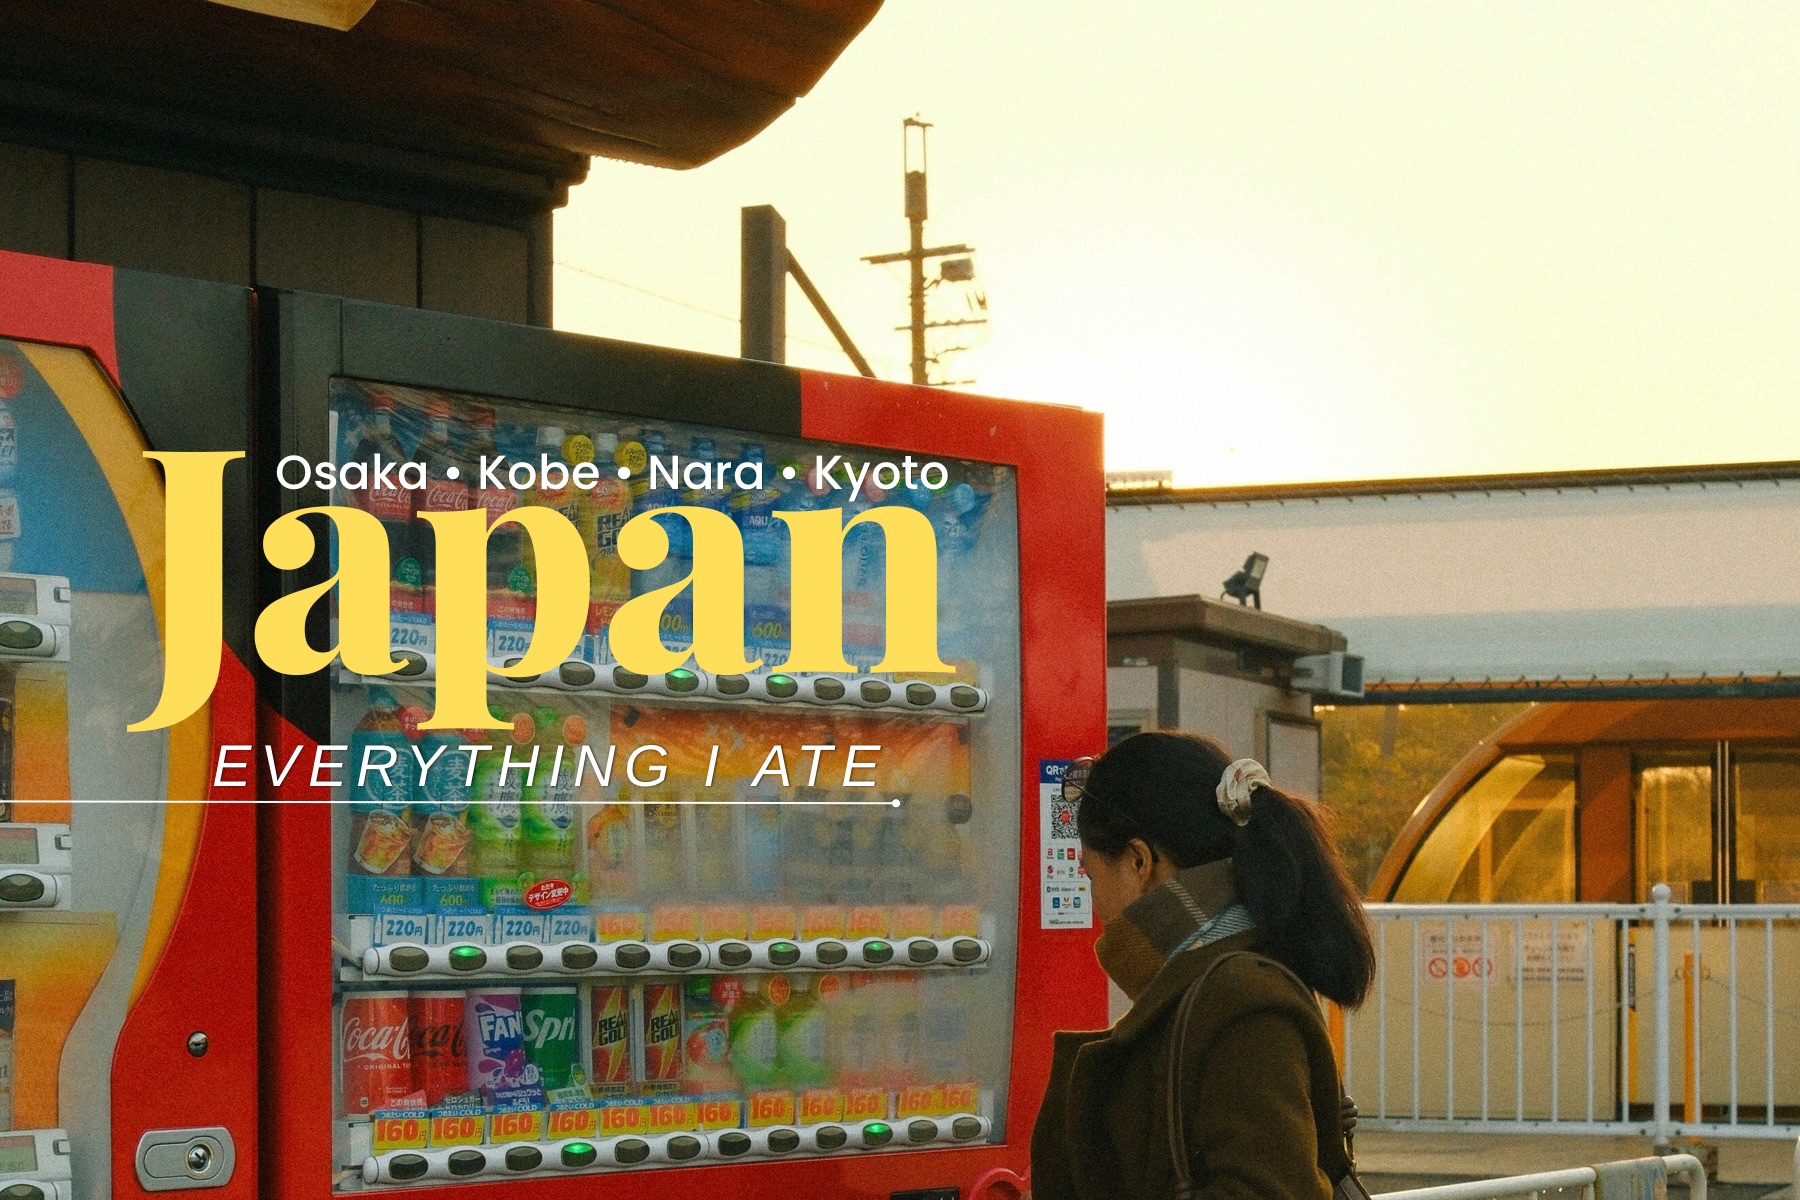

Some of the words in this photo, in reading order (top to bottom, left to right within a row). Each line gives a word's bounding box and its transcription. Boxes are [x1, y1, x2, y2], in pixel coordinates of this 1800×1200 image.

[528, 887, 569, 903] デザイン変更中
[386, 919, 423, 937] 220円
[447, 920, 484, 938] 220円
[506, 920, 541, 937] 220円
[363, 1062, 401, 1071] ORIGINAL
[517, 1104, 538, 1112] COLD
[575, 1101, 595, 1110] COLD
[623, 1098, 644, 1106] COLD
[459, 1108, 481, 1117] COLD
[550, 1110, 597, 1133] 160円
[602, 1107, 647, 1129] 160円
[649, 1104, 694, 1126] 160円
[376, 1118, 427, 1142] 160円
[433, 1116, 482, 1141] 160円
[494, 1112, 541, 1137] 160円
